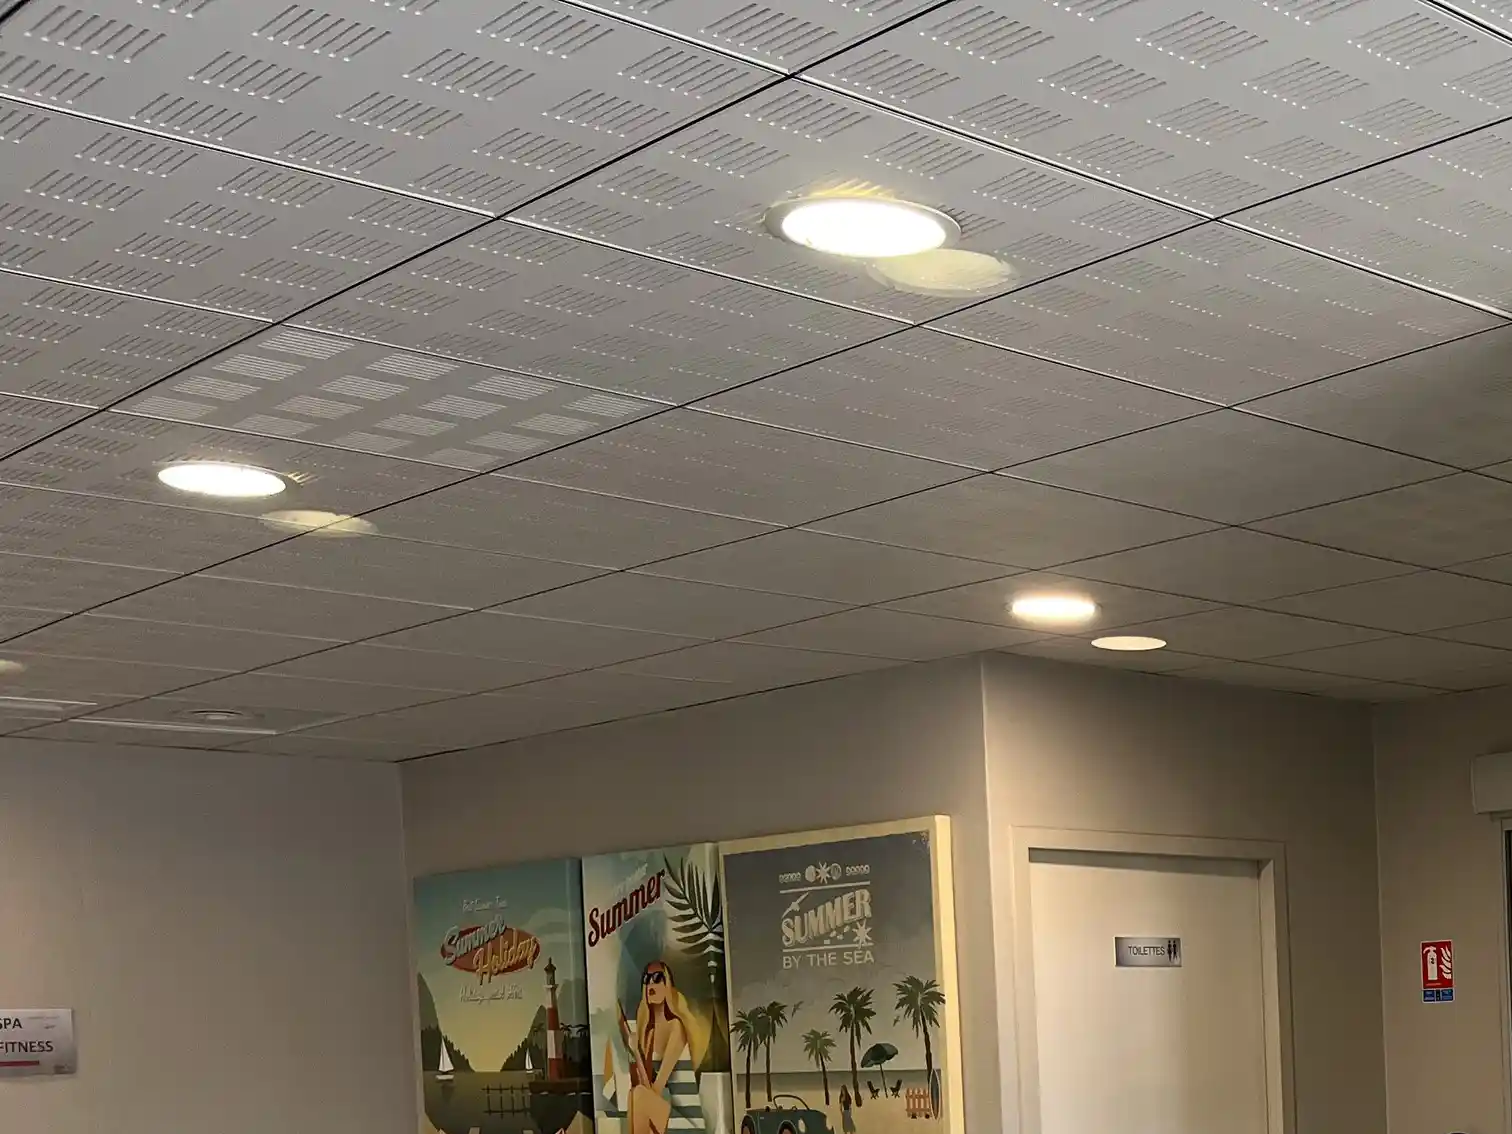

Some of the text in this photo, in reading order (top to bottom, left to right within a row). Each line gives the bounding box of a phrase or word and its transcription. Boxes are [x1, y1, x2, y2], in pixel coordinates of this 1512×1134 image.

[588, 869, 666, 948] Summer
[781, 888, 873, 948] SUMMER
[442, 915, 508, 966] Summer
[473, 927, 540, 986] Holiday
[782, 950, 875, 969] BY THE SEA
[1128, 945, 1165, 955] TOILETTES
